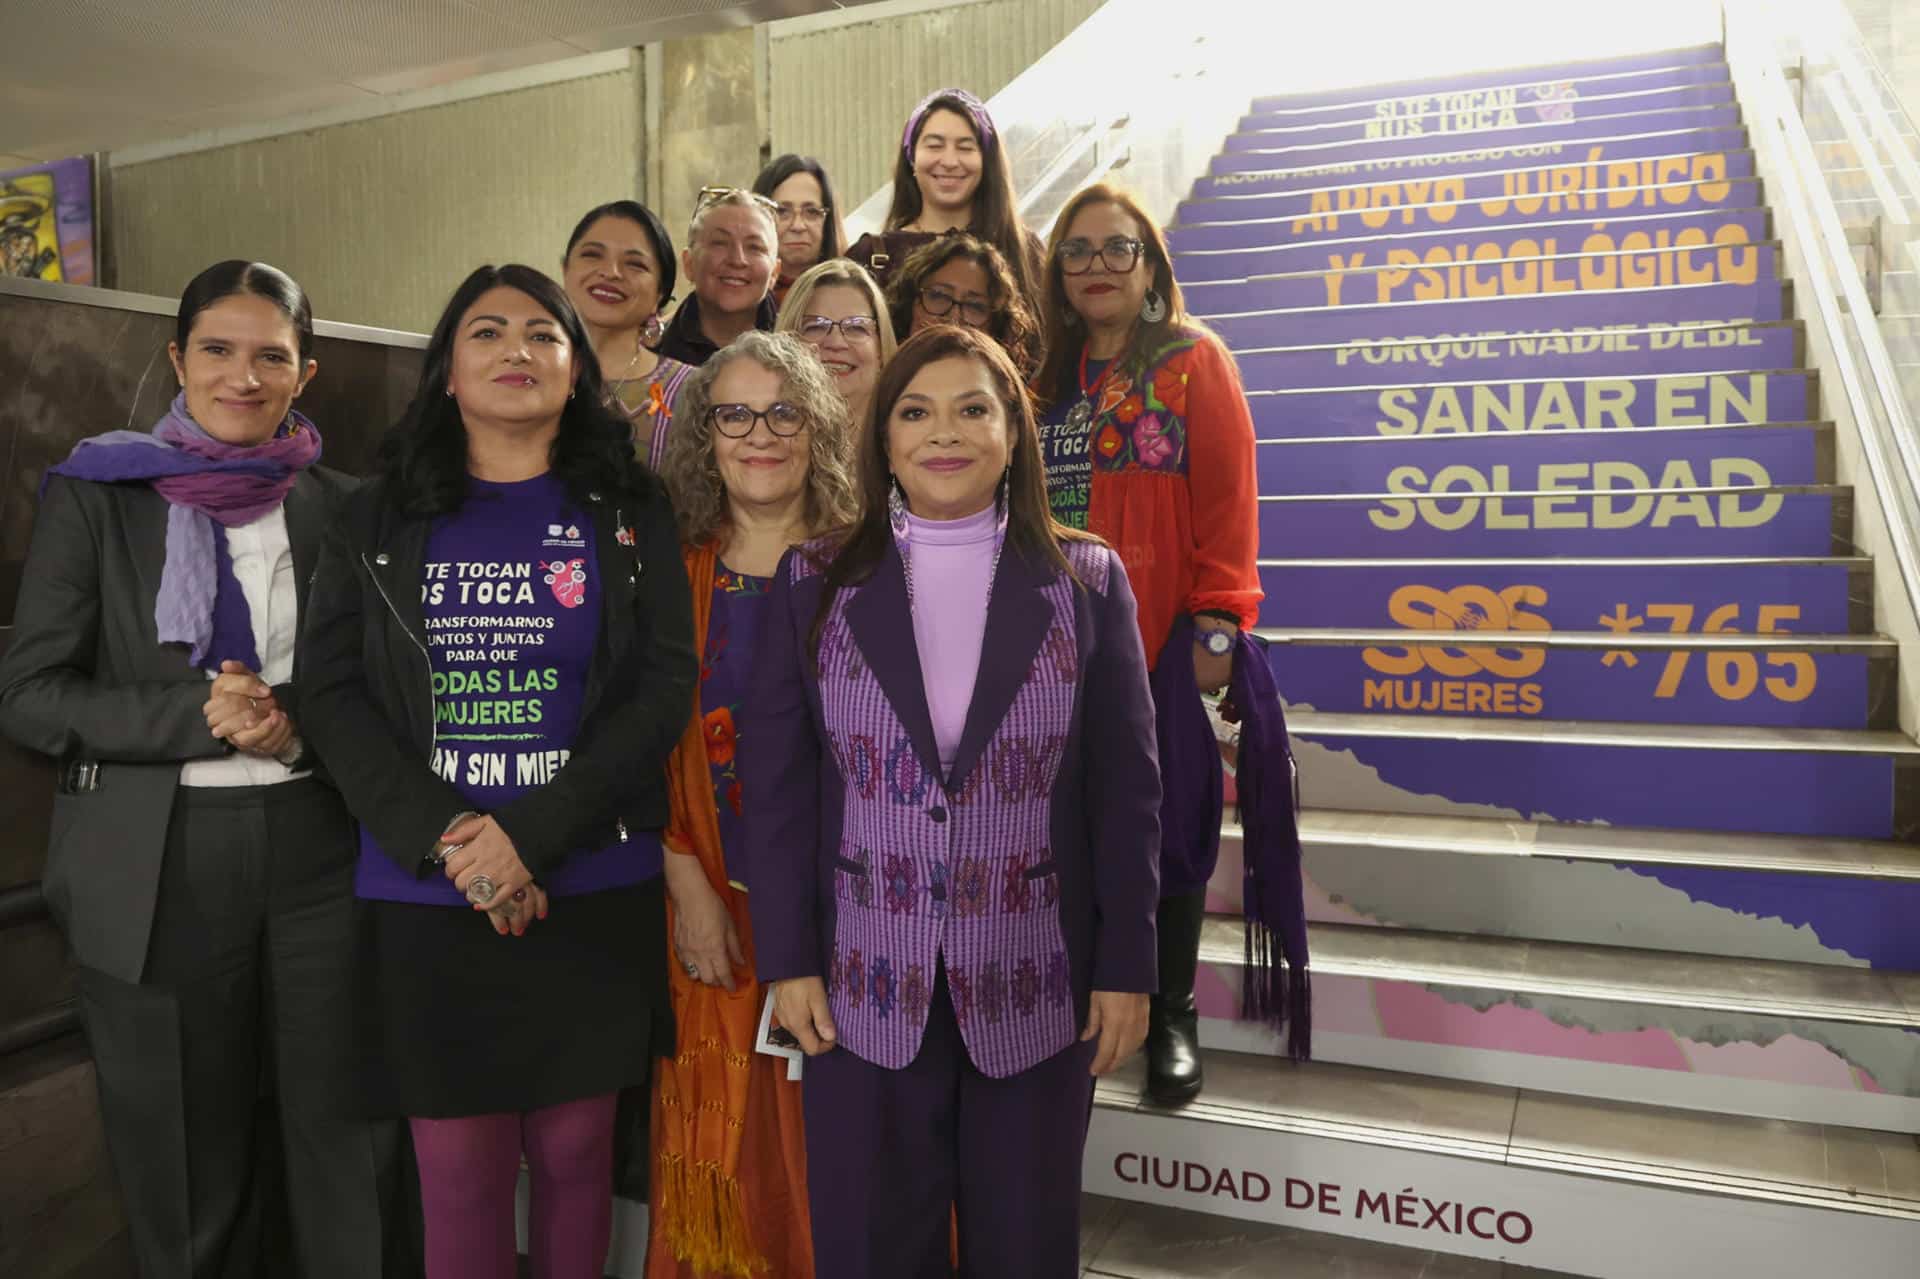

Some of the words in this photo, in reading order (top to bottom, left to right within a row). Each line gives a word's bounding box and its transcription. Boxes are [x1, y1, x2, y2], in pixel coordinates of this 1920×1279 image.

[1292, 176, 1465, 234] APOYO
[1480, 146, 1733, 217] JURÍDICO
[1324, 251, 1366, 306] Y
[1376, 222, 1759, 304] PSICOLÓGICO
[1336, 331, 1507, 368] PORQUE
[1509, 324, 1641, 357] NADIE
[1648, 318, 1763, 350] DEBE
[1375, 377, 1637, 436] SANAR
[1655, 374, 1769, 426] EN
[1368, 457, 1785, 531] SOLEDAD
[425, 562, 451, 580] TE
[456, 561, 531, 579] TOCAN
[458, 581, 536, 606] TOCA
[478, 633, 488, 645] Y
[491, 633, 544, 646] JUNTAS
[1361, 584, 1552, 679] SOS
[446, 650, 485, 662] PARA
[490, 649, 518, 663] QUE
[432, 669, 502, 696] ODAS
[508, 667, 559, 692] LAS
[1362, 679, 1544, 714] MUJERES
[436, 698, 543, 725] MUJERES
[466, 752, 507, 786] SIN
[1113, 1151, 1271, 1203] CIUDAD
[1285, 1177, 1342, 1216] DE
[1355, 1187, 1534, 1245] MÉXICO
